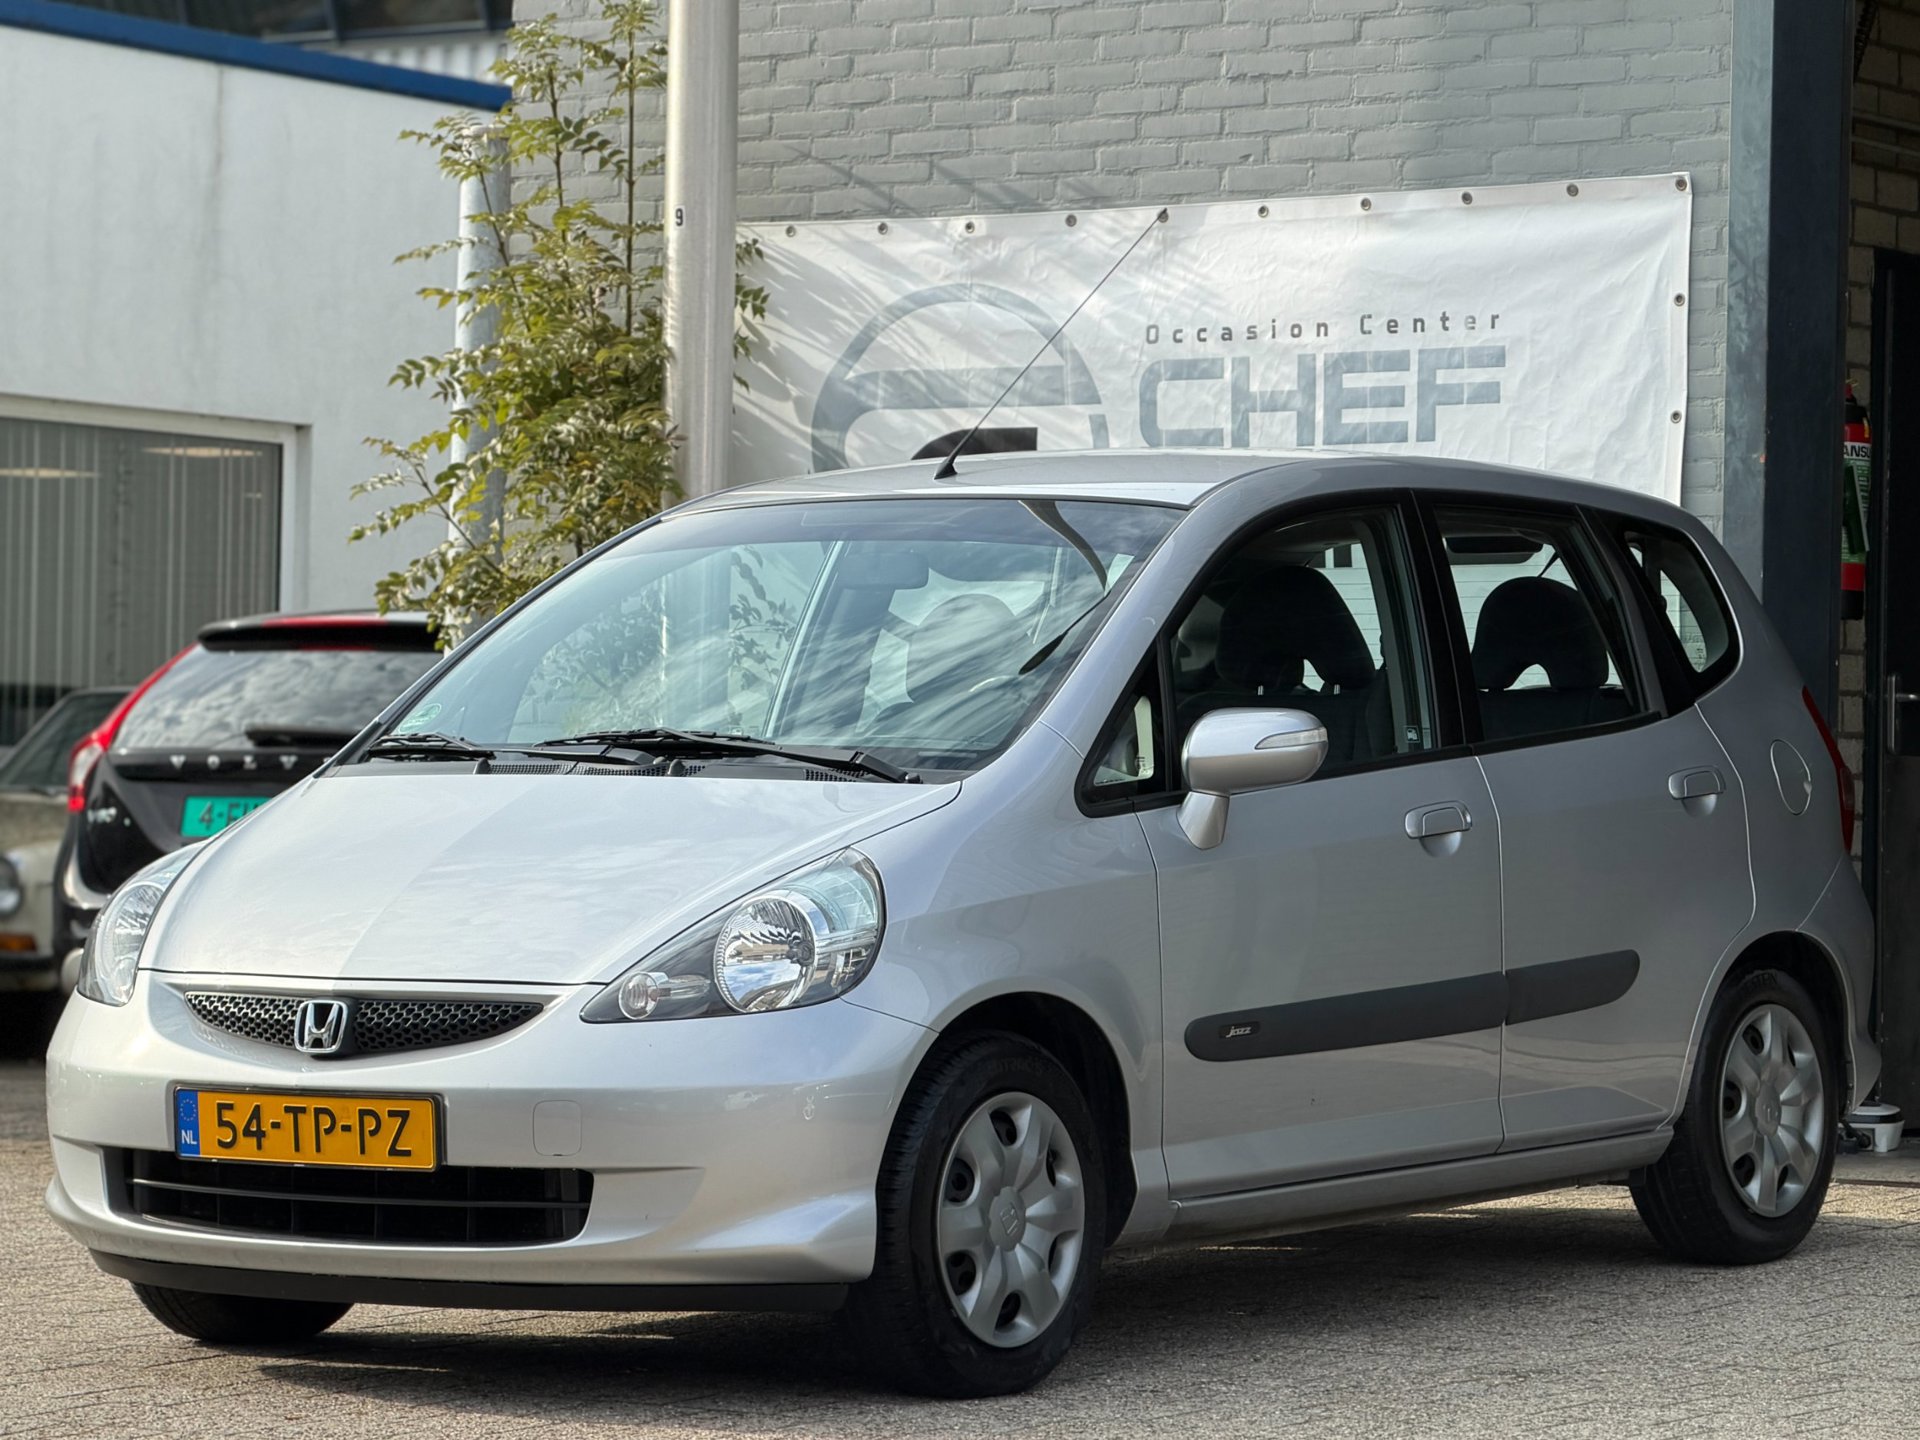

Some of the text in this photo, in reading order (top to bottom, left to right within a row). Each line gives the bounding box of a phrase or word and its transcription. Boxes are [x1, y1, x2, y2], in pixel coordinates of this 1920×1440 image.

[675, 207, 684, 227] 9
[1145, 311, 1501, 345] Occasion Center
[1138, 345, 1507, 448] CHEF
[180, 1128, 198, 1146] NL
[215, 1100, 413, 1158] 54-TP-PZ
